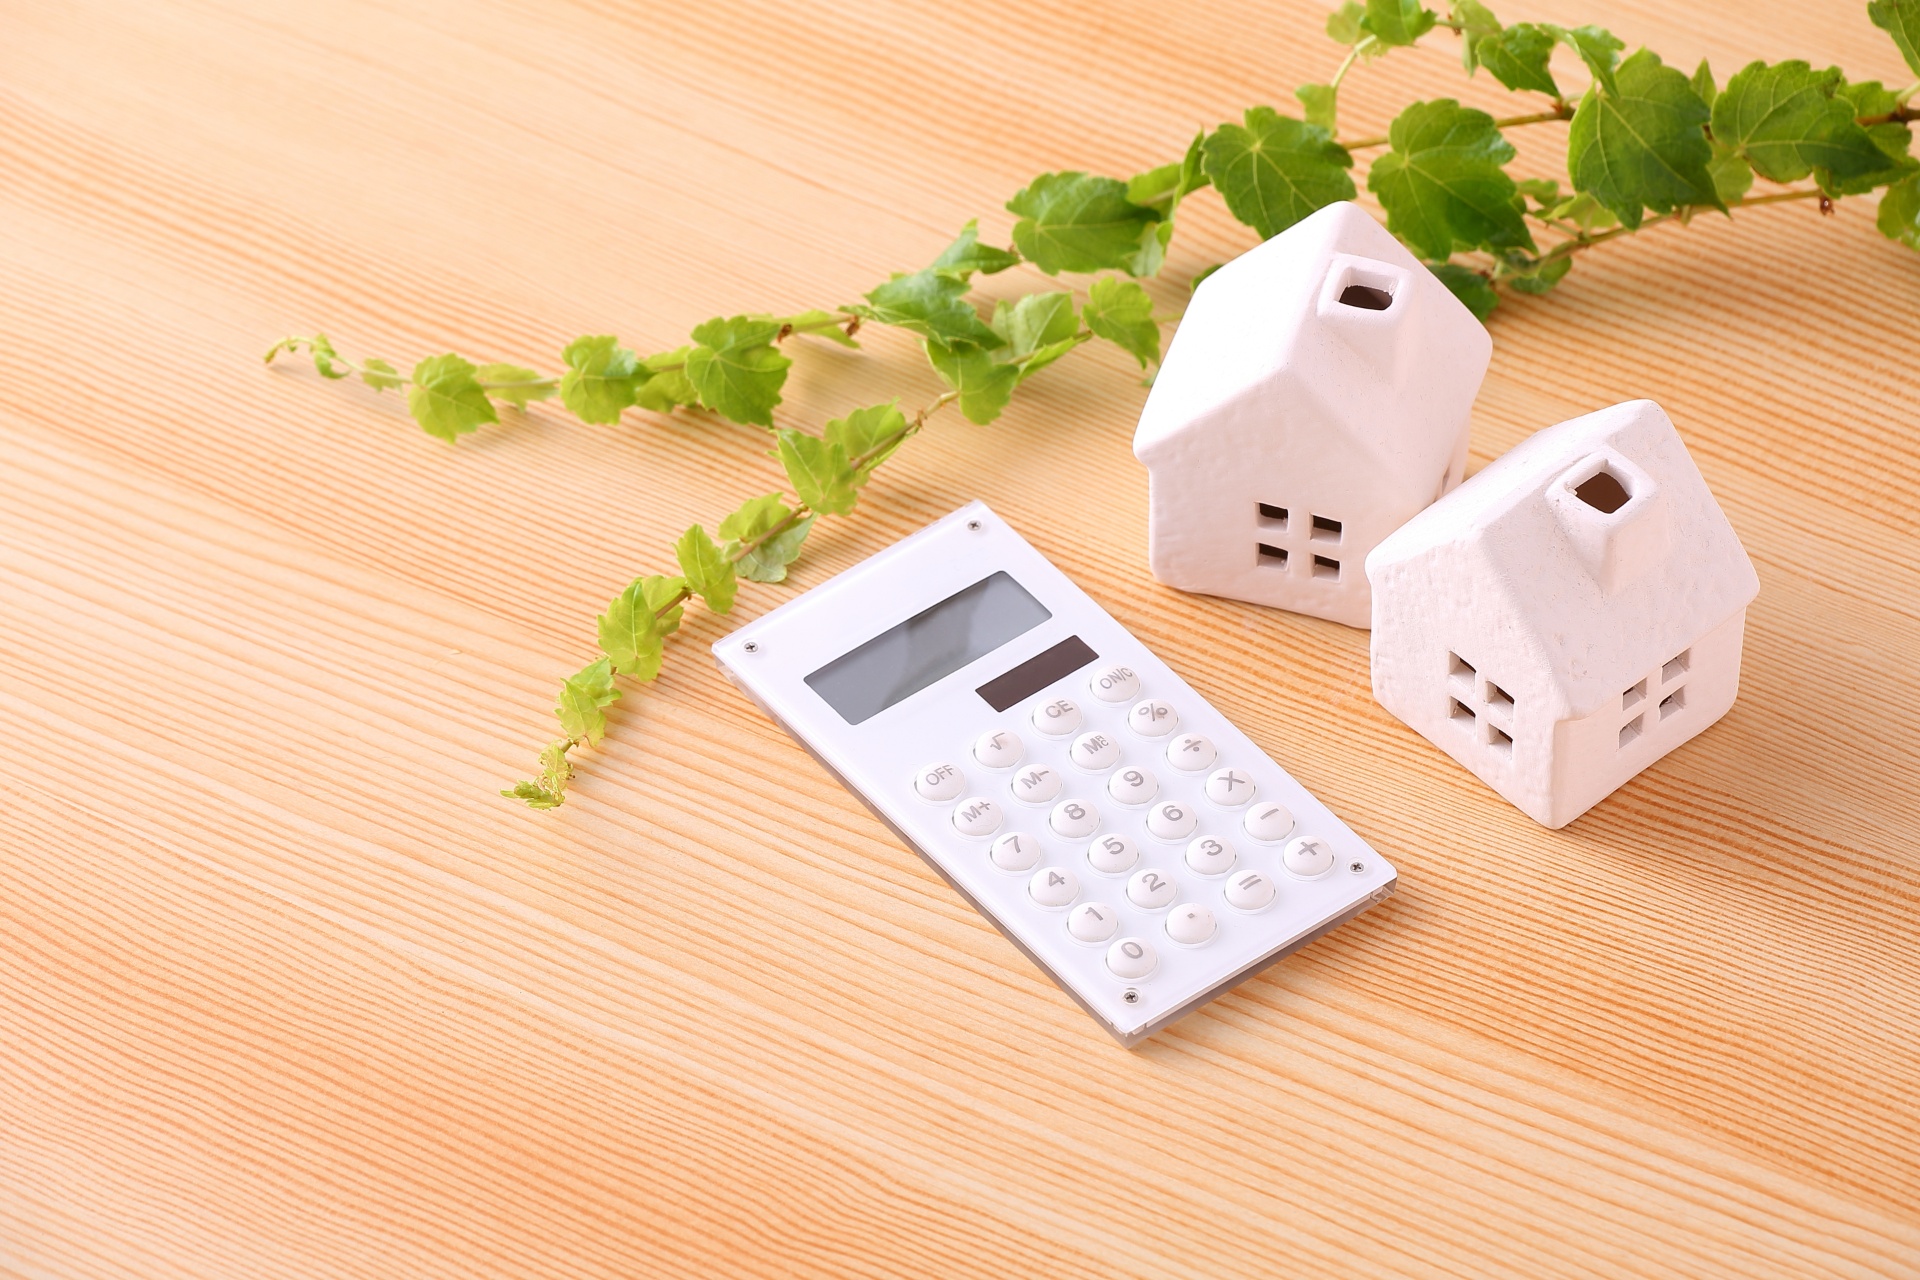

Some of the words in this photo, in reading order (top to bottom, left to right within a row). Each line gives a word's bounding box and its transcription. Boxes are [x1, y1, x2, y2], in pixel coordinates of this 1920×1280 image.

[1100, 667, 1132, 690] ON/C
[1045, 700, 1073, 719] CE
[1138, 703, 1168, 722] %
[925, 764, 954, 786] OFF
[1123, 770, 1144, 787] 9
[961, 801, 991, 823] M+
[1064, 803, 1086, 821] 8
[1162, 805, 1184, 822] 6
[1002, 835, 1022, 854] 7
[1102, 837, 1125, 855] 5
[1200, 839, 1223, 856] 3
[1048, 871, 1066, 888] 4
[1141, 873, 1166, 892] 2
[1085, 906, 1104, 922] 1
[1121, 941, 1144, 960] 0
